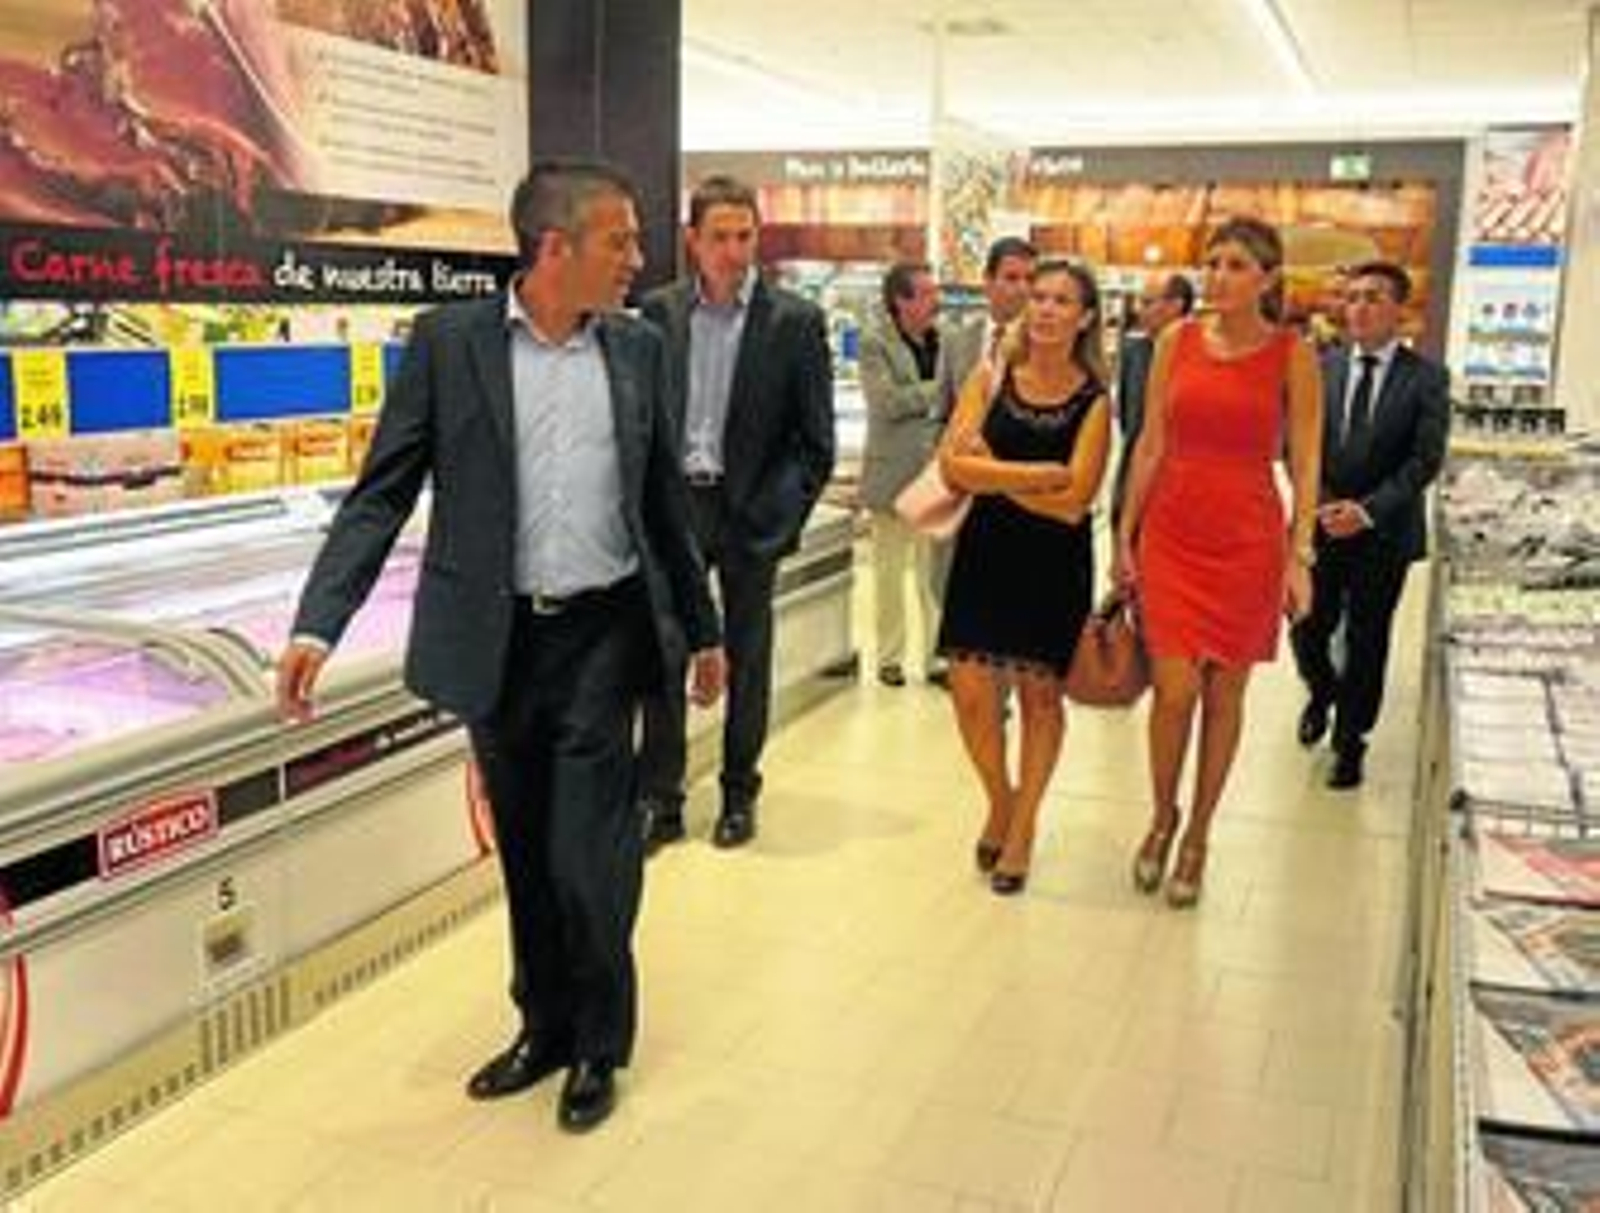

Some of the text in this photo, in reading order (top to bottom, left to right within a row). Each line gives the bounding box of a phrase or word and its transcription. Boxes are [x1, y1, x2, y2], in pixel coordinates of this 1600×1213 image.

[9, 235, 497, 294] Carne fresca de nuestra tierra
[218, 876, 236, 911] 5
